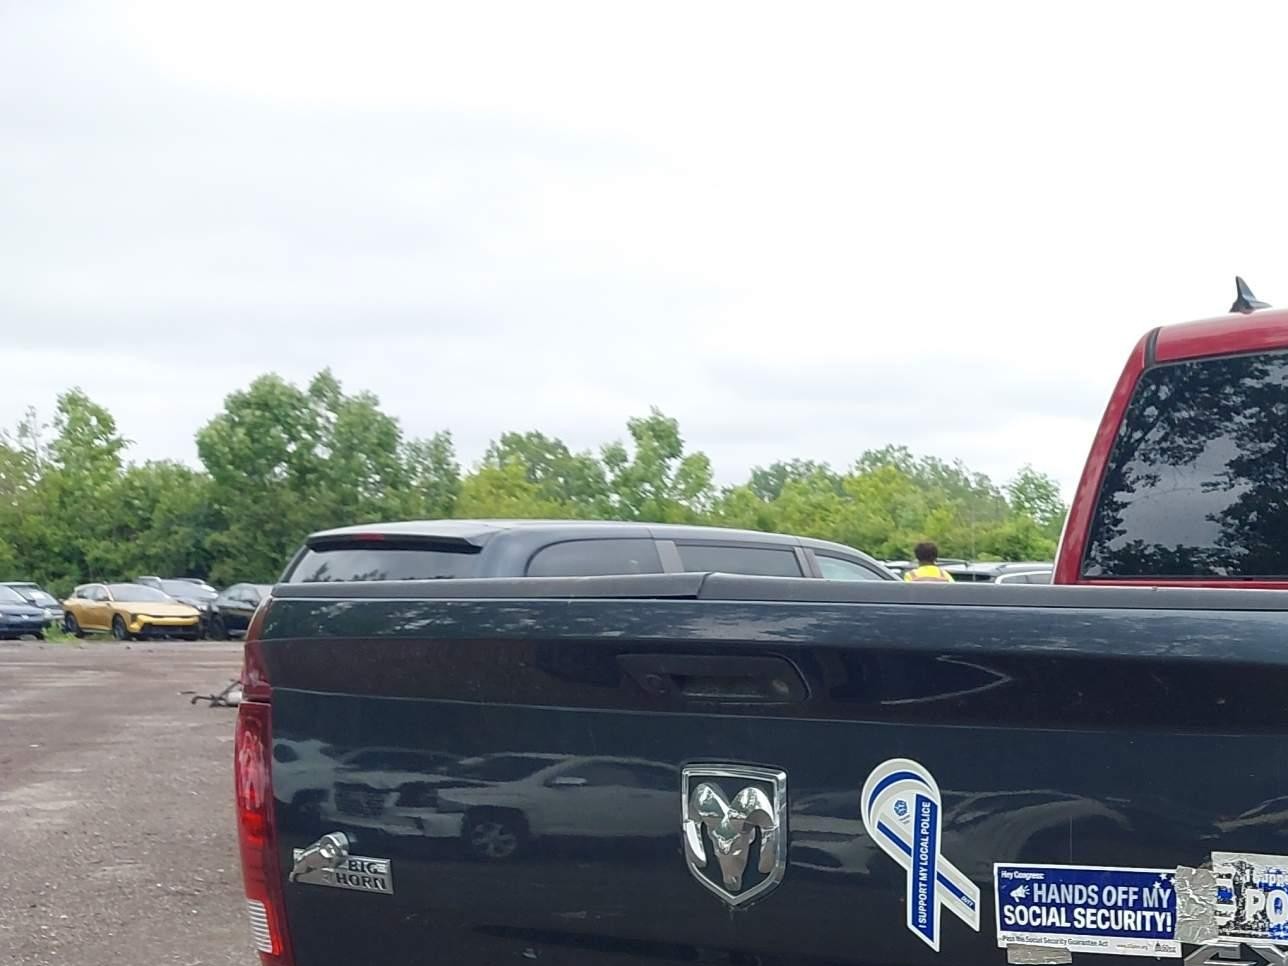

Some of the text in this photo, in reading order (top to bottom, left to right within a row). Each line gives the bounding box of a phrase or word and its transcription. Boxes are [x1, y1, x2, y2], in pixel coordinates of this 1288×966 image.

[921, 801, 931, 835] POLICE
[920, 835, 929, 865] LOCAL
[348, 860, 378, 874] BIG
[920, 866, 928, 882] MY
[336, 872, 387, 890] HORN
[919, 883, 927, 923] SUPPORT
[1033, 883, 1171, 909] HANDS OFF MY
[1003, 905, 1172, 932] SOCIAL SECURITY!
[1043, 936, 1067, 945] Security
